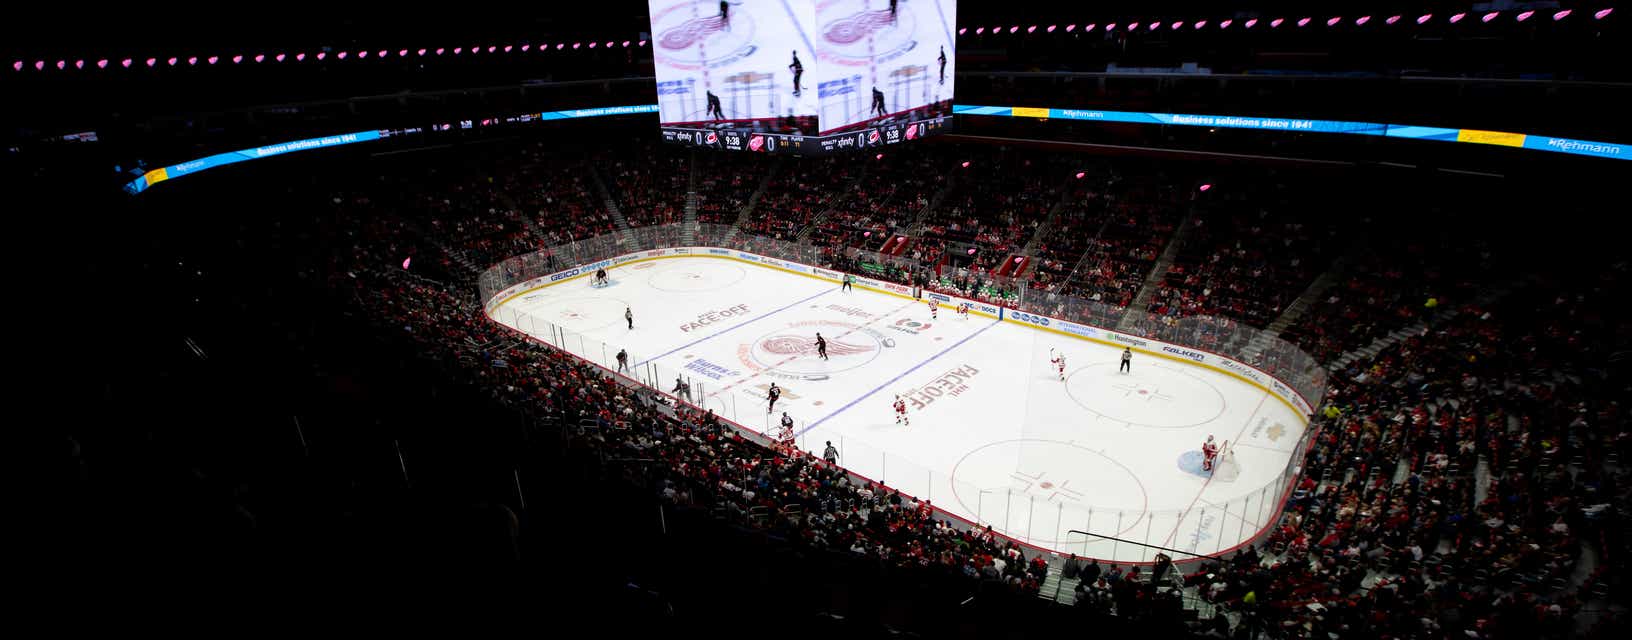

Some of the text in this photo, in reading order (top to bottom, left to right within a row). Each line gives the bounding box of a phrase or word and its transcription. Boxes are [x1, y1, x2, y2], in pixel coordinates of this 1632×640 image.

[1172, 114, 1313, 129] Business solutions since 1941
[886, 129, 899, 140] 9:38
[920, 123, 925, 136] 0
[696, 131, 702, 145] 0
[725, 136, 740, 146] 9:38
[767, 136, 775, 151] 0
[838, 137, 854, 148] xfinity
[858, 133, 865, 148] 0
[257, 145, 287, 156] Business
[287, 140, 321, 151] solutions
[321, 137, 341, 146] since
[1556, 138, 1621, 154] Rehmann
[551, 269, 579, 281] GEICO
[1162, 346, 1205, 359] FALKEN
[947, 383, 969, 400] NHL
